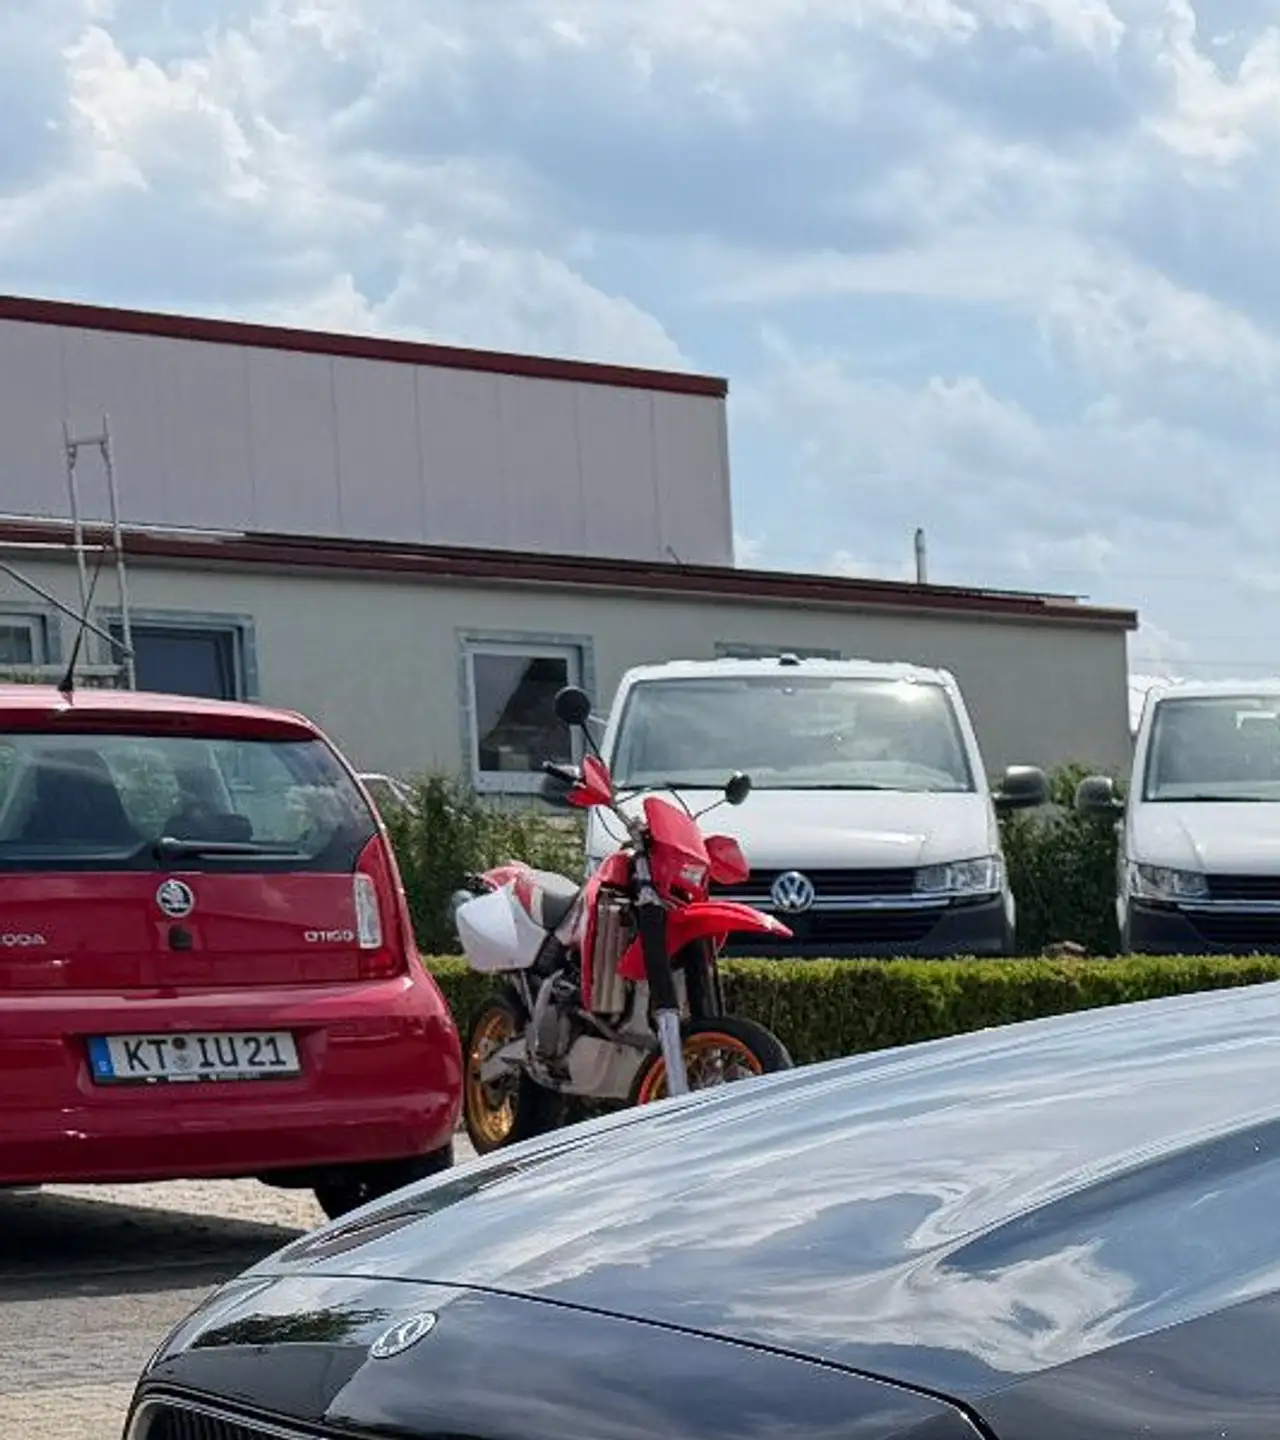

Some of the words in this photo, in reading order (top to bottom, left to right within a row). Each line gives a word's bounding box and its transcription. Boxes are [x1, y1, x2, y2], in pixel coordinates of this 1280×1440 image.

[124, 1039, 167, 1072] KT
[197, 1036, 239, 1069] IU
[243, 1035, 287, 1067] 21
